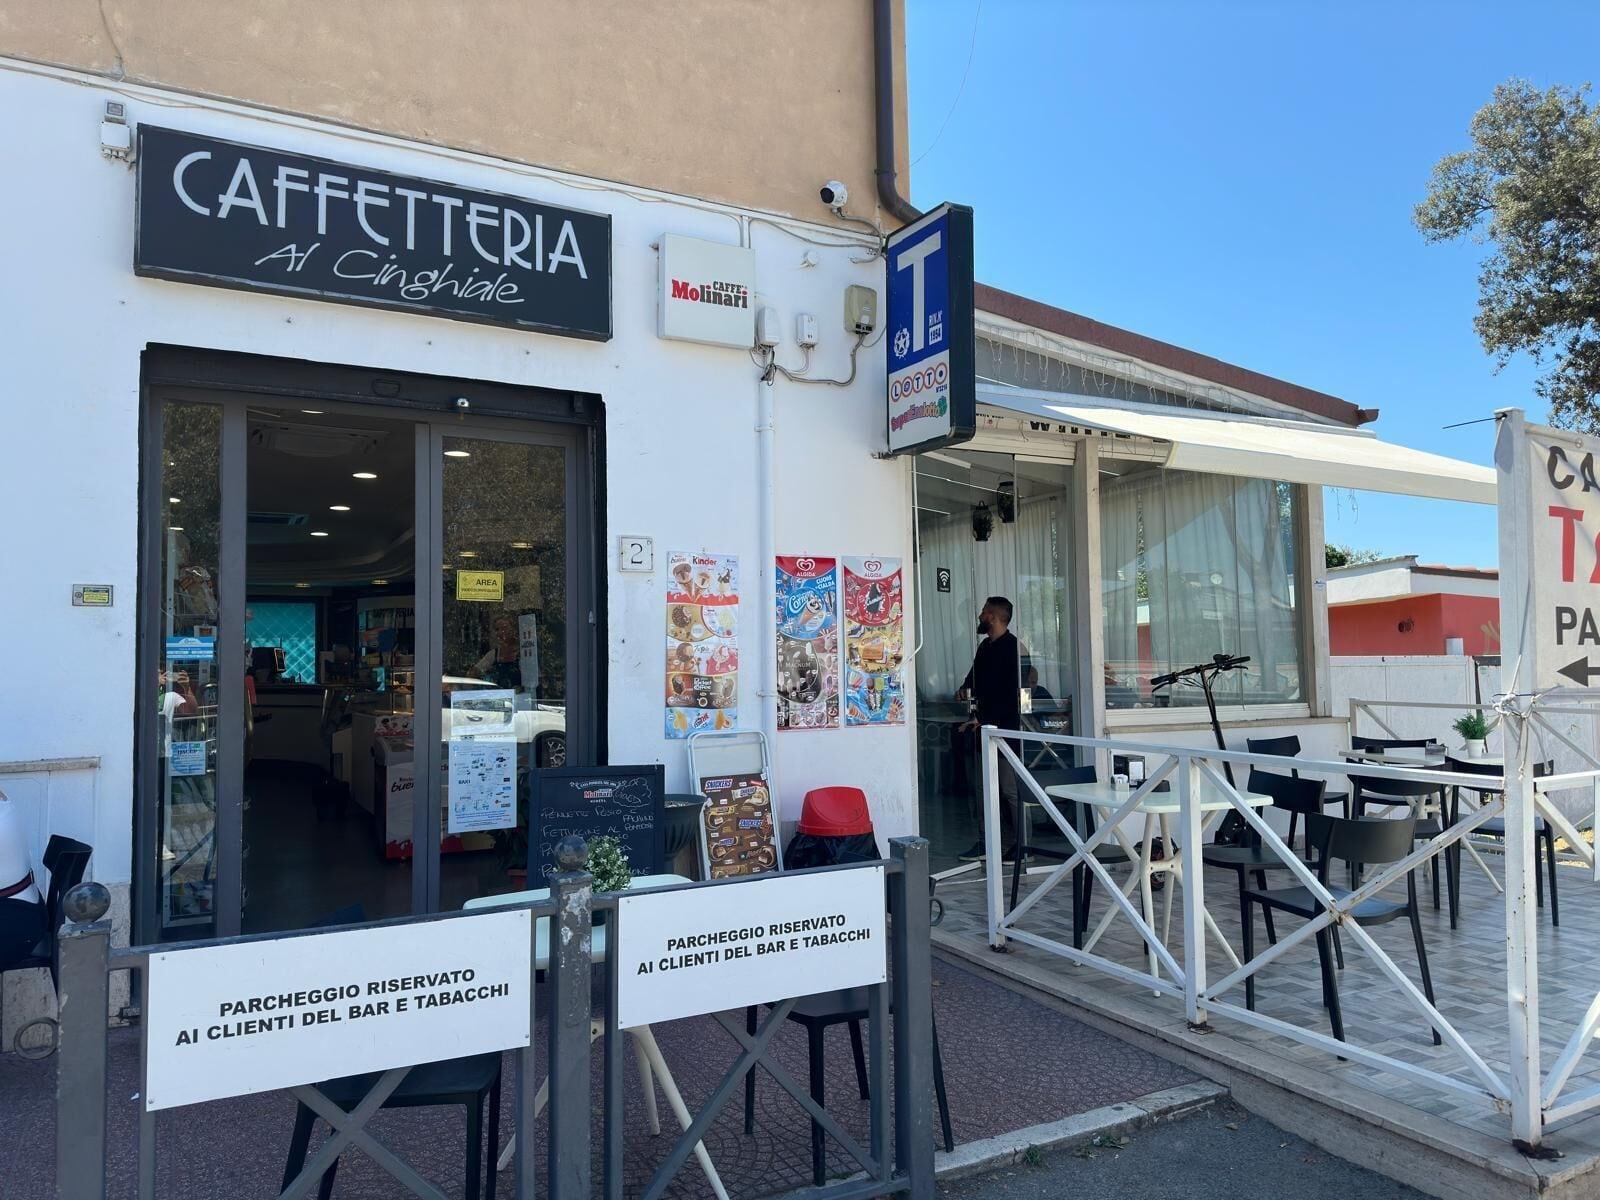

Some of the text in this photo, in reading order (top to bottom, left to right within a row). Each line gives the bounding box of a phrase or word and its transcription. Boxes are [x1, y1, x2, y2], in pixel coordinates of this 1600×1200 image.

[172, 150, 588, 279] CAFFETTERIA
[255, 242, 525, 305] Al Cinghiale
[671, 279, 748, 308] Molinari
[897, 230, 942, 353] T
[891, 362, 947, 402] LOTTO
[630, 542, 643, 565] 2
[692, 556, 717, 566] Kinder
[1548, 505, 1600, 584] T
[476, 578, 498, 586] AREA
[584, 790, 613, 798] Molinari
[706, 779, 732, 789] SNICKERS
[637, 928, 871, 975] AI CLIENTI DEL BAR E TABACCHI
[667, 914, 846, 951] PARCHEGGIO RISERVATO
[219, 968, 475, 1017] PARCHEGGIO RISERVATO
[175, 982, 510, 1046] AI CLIENTI DEL BAR E TABACCHI
